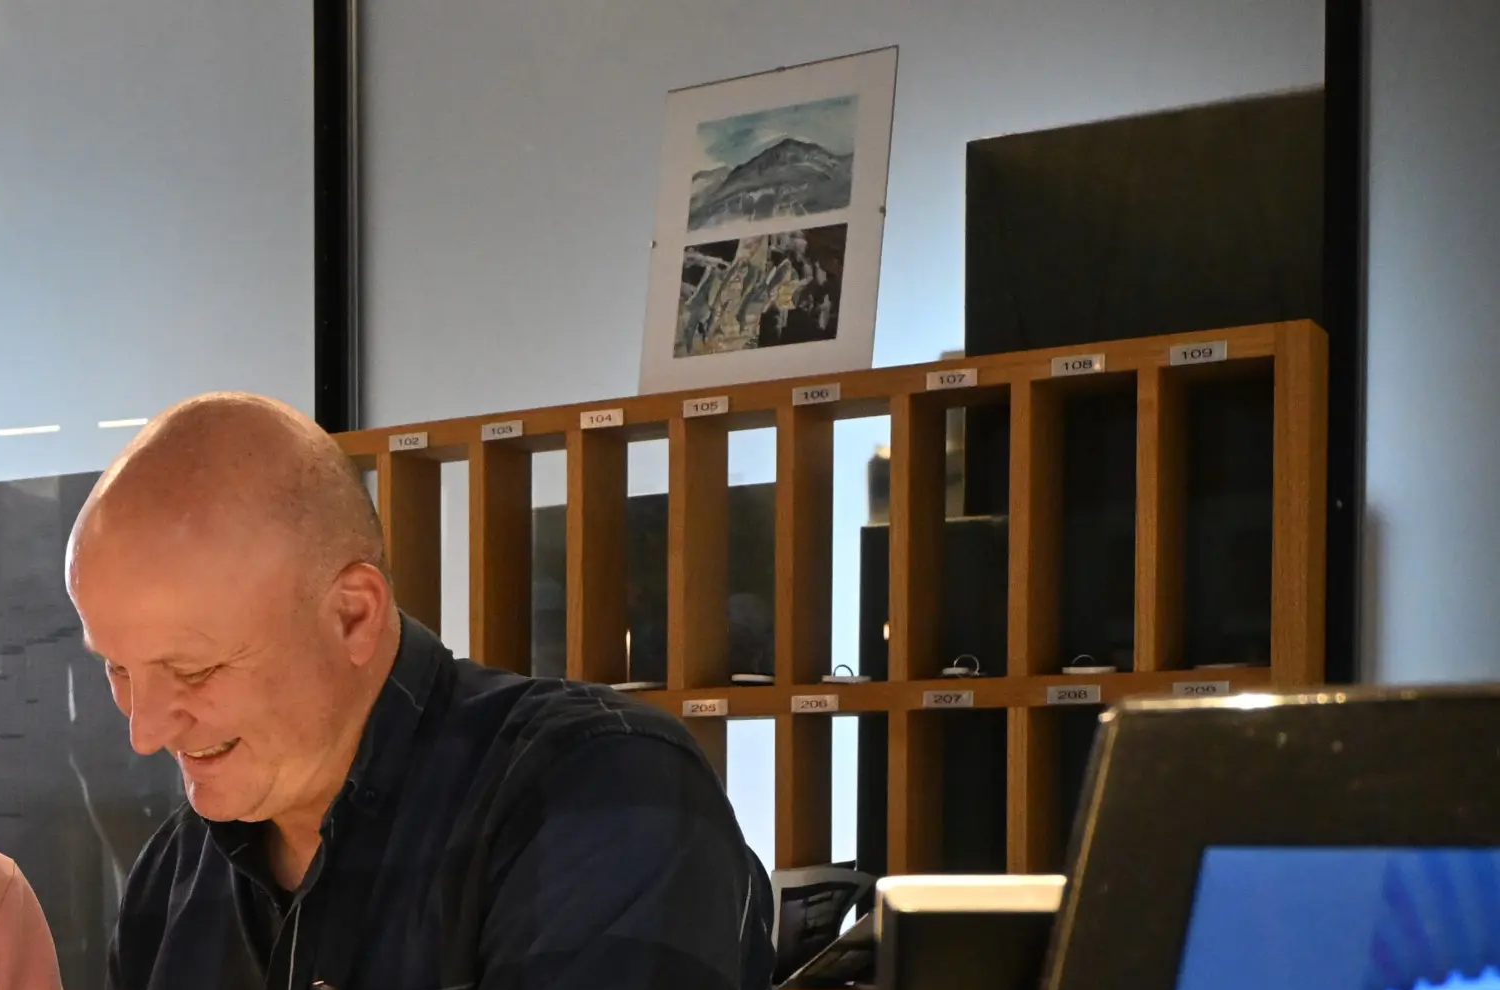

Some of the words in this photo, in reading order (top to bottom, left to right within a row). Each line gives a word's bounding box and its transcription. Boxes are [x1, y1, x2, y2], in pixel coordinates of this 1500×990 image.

[1181, 347, 1213, 360] 109
[1061, 359, 1093, 371] 108
[938, 373, 966, 385] 107
[803, 388, 829, 400] 106
[693, 401, 719, 413] 105
[588, 414, 613, 424] 104
[490, 425, 513, 435] 103
[398, 436, 420, 446] 102
[933, 693, 962, 704] 207
[1057, 690, 1088, 700] 208
[690, 703, 716, 713] 205
[800, 700, 828, 710] 206
